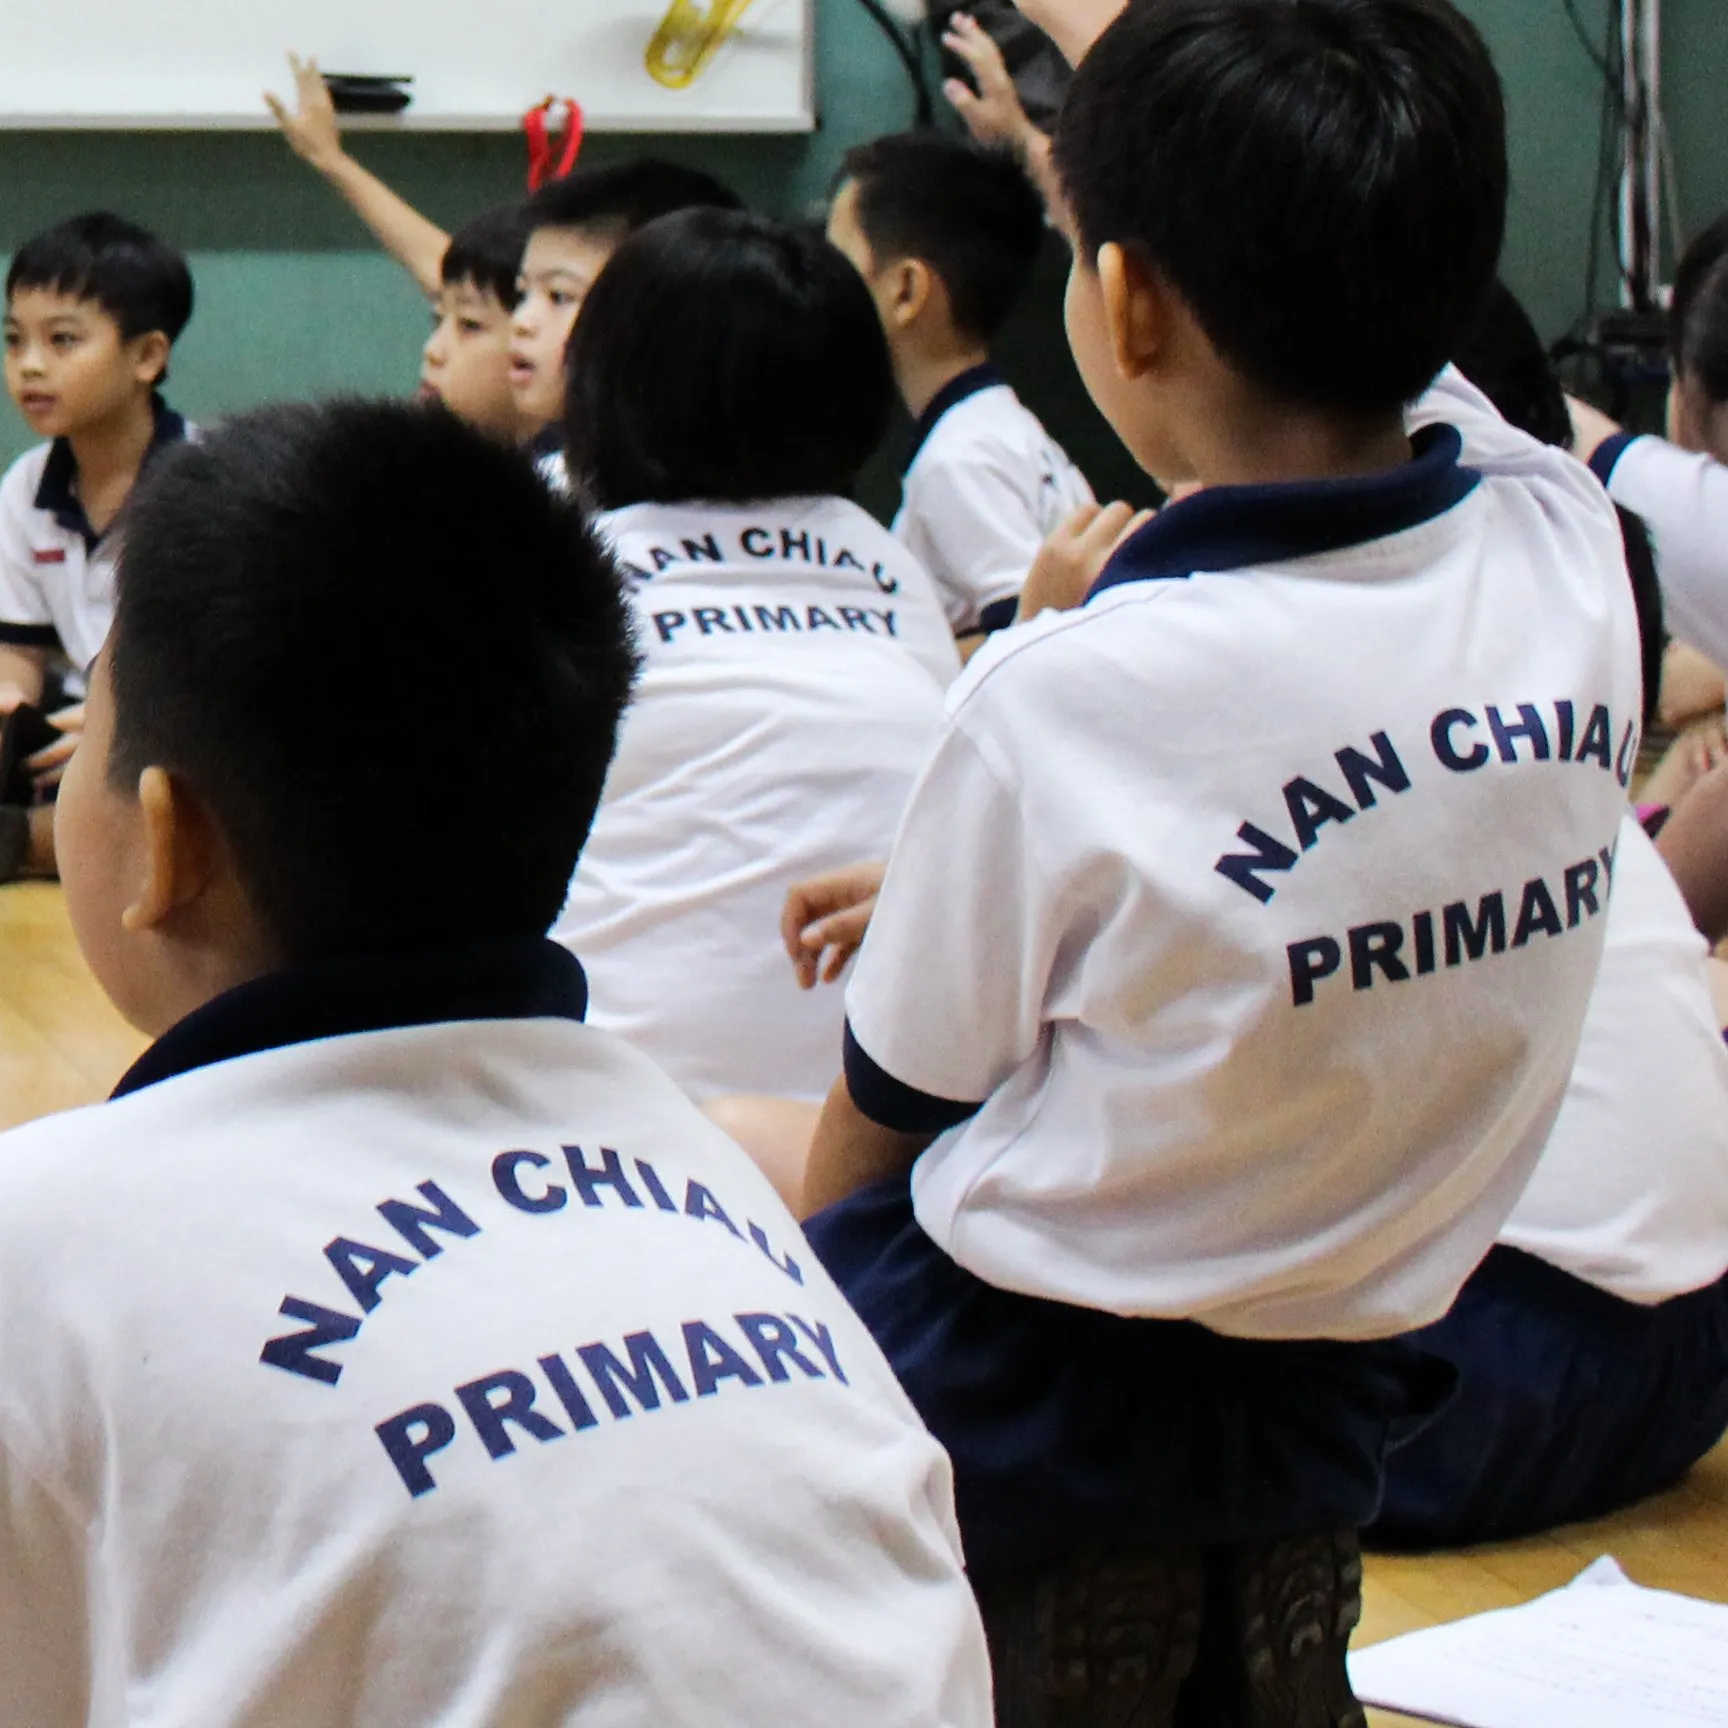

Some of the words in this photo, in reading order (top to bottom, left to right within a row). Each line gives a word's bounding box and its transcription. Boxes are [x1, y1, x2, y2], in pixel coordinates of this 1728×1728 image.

[653, 605, 896, 644] PRIMARY
[1214, 730, 1412, 905] NAN
[258, 1177, 483, 1388] NAN
[489, 1143, 806, 1286] CHIAU
[373, 1310, 850, 1499] PRIMARY
